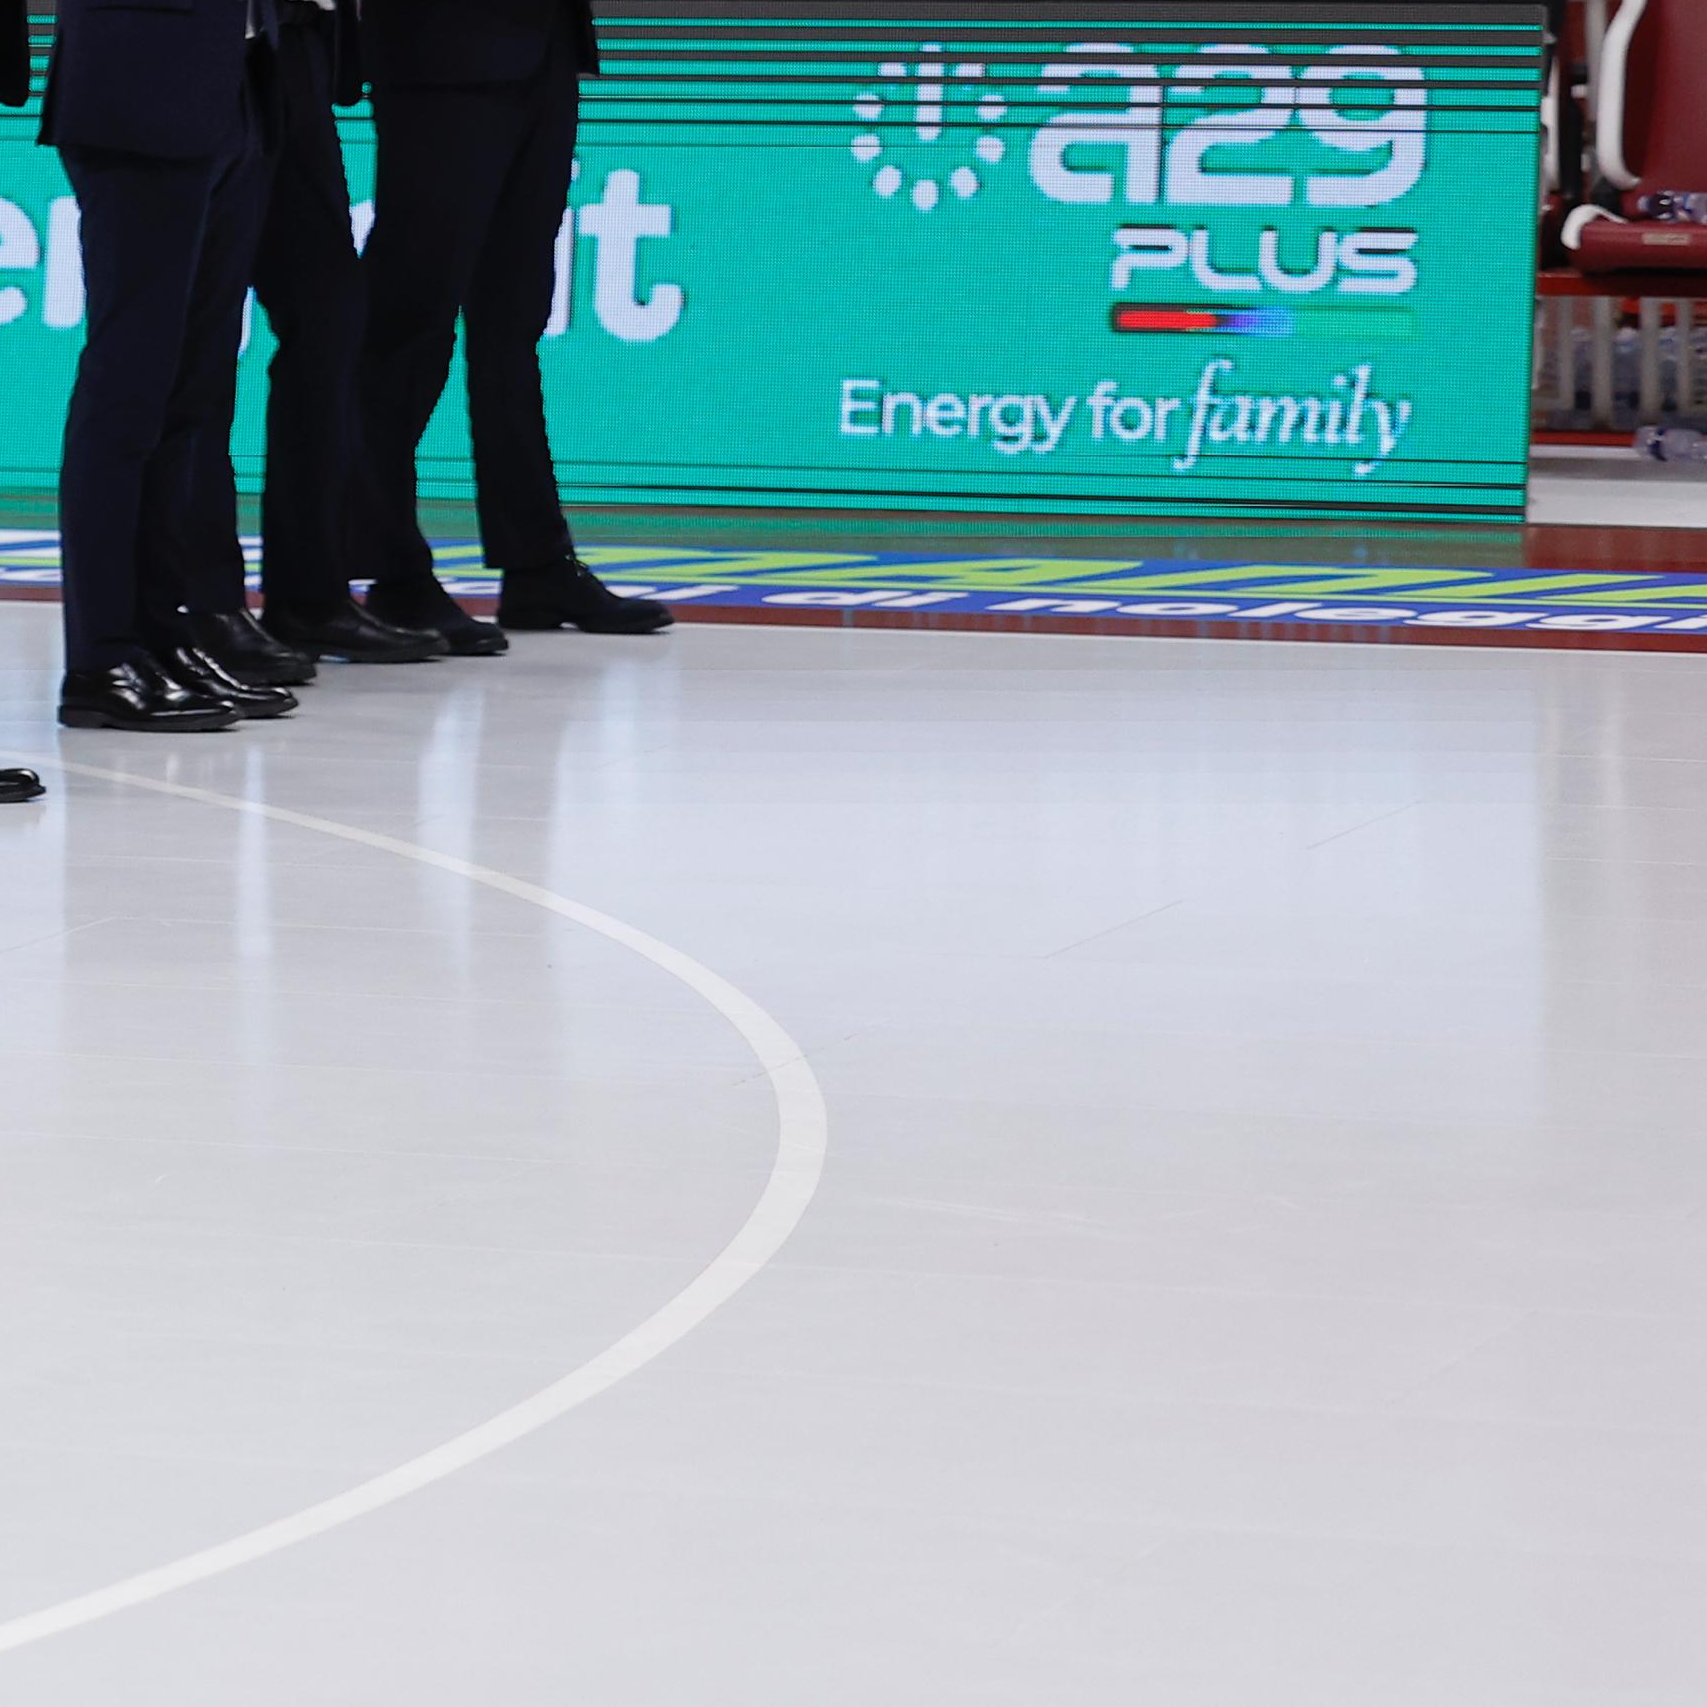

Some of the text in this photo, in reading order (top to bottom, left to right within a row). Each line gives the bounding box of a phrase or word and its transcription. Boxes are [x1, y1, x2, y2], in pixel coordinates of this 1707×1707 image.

[1028, 44, 1427, 207] a29
[1110, 225, 1420, 293] PLUS
[839, 357, 1412, 477] Energy for family
[984, 595, 1707, 632] noleggi
